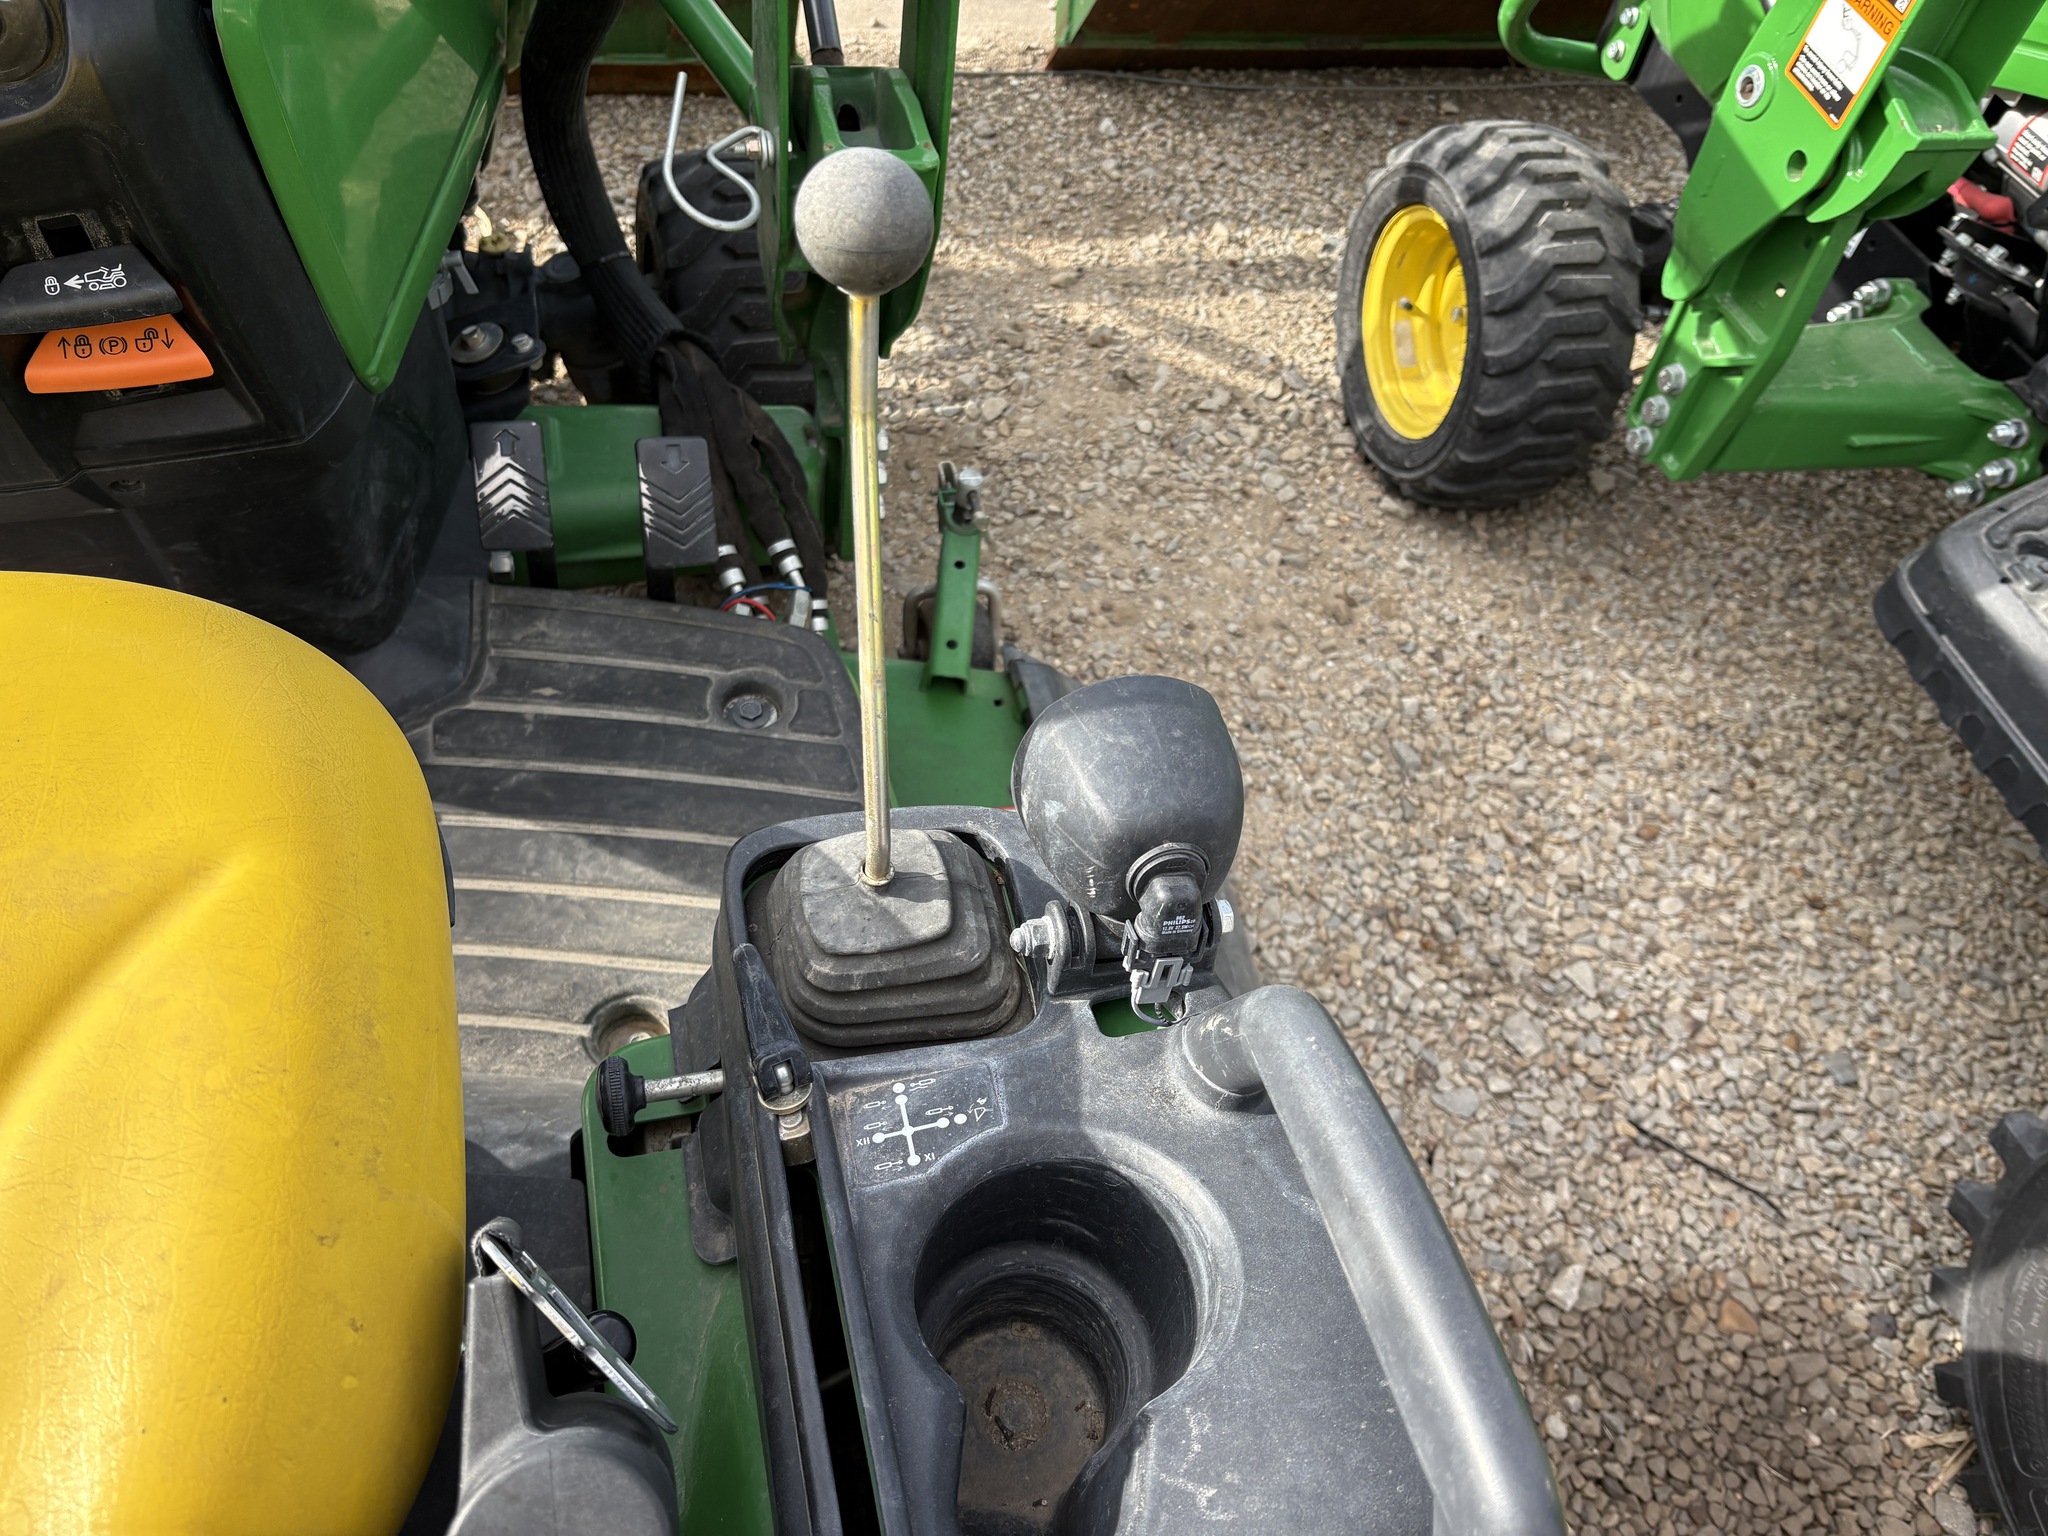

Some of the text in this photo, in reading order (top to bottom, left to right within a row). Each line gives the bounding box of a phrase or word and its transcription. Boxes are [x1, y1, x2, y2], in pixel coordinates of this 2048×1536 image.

[1853, 0, 1894, 35] ARNING
[856, 1137, 870, 1147] XII
[924, 1152, 936, 1162] XI
